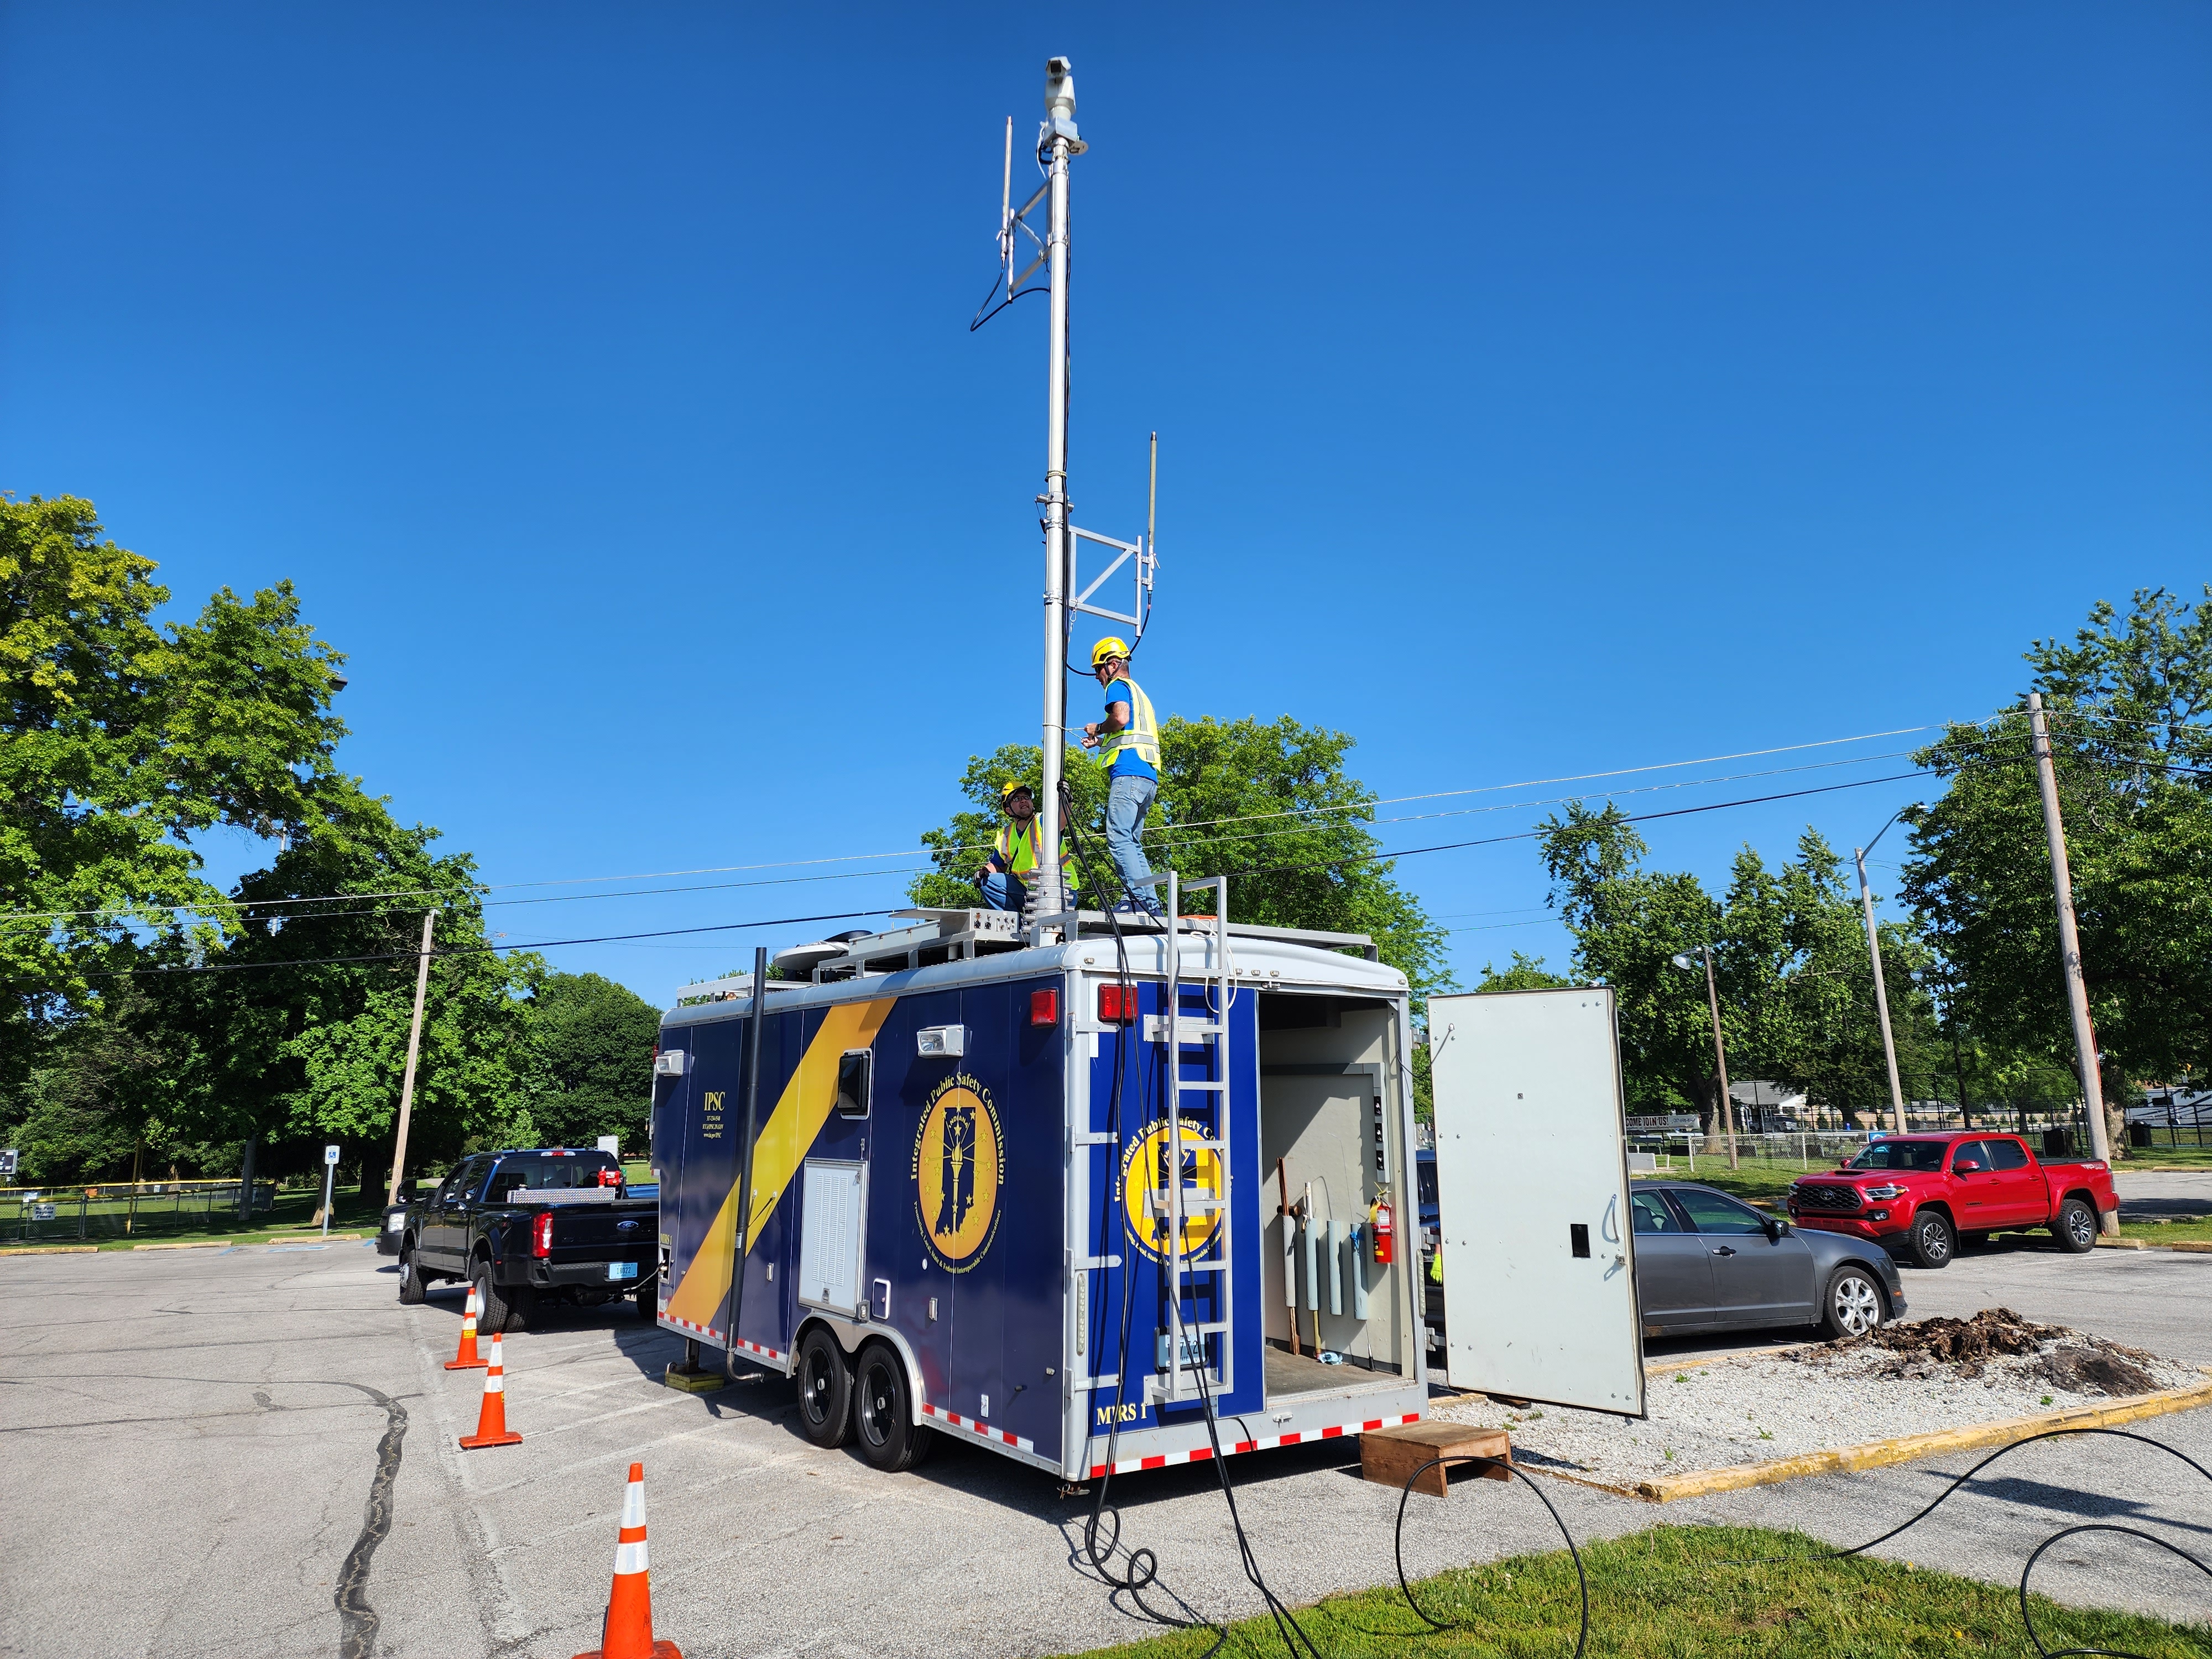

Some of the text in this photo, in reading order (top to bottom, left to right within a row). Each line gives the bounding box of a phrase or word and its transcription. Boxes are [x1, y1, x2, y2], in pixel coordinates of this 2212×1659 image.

[703, 1091, 726, 1112] IPSC
[911, 1072, 1005, 1185] Integrated Public Safety Commission
[948, 1115, 968, 1129] INDIANA
[1180, 1117, 1202, 1133] afety
[1626, 1117, 1668, 1126] COME JOIN US!
[931, 1250, 939, 1264] State
[943, 1262, 957, 1274] Federal
[957, 1256, 980, 1274] Interoperable
[979, 1209, 1001, 1259] Communications
[1147, 1253, 1158, 1263] State
[1140, 1402, 1147, 1419] 1
